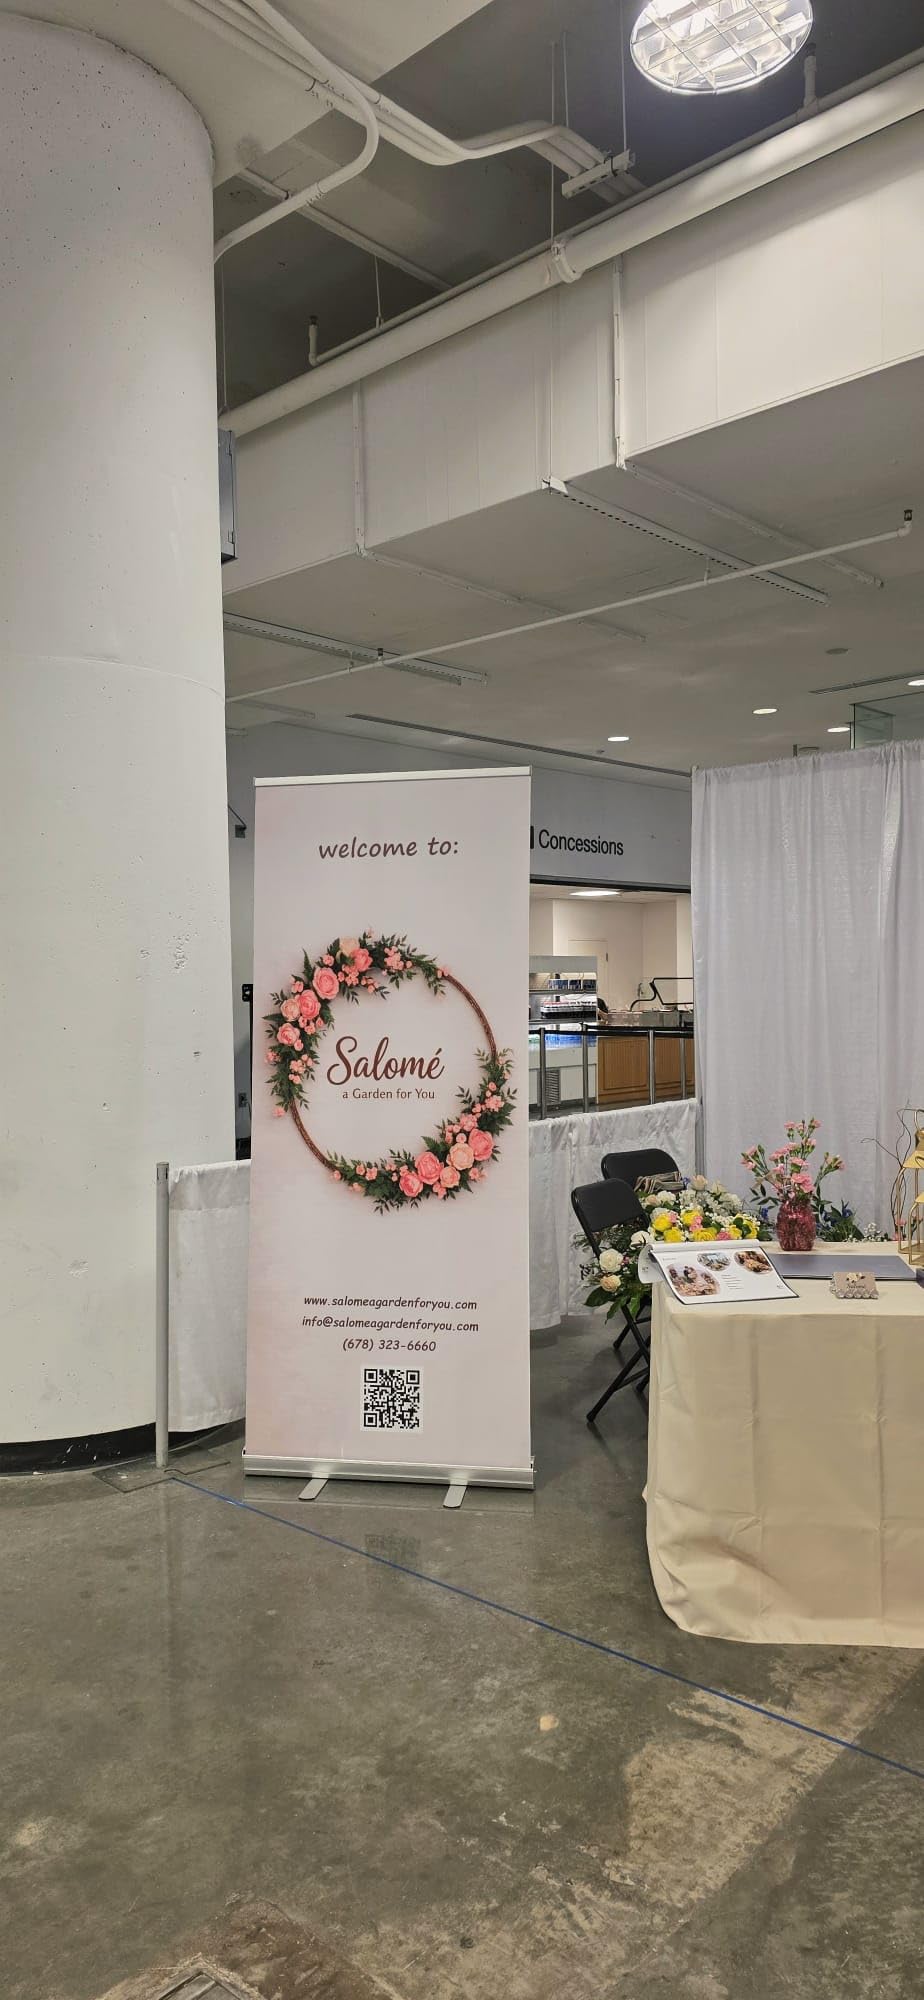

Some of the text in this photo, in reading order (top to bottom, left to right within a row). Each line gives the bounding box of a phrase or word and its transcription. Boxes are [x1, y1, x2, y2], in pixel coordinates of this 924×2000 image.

[318, 836, 459, 858] welcome to:
[538, 829, 624, 856] Concessions
[327, 1036, 445, 1086] Salomé
[342, 1087, 435, 1099] a Garden for You
[304, 1296, 477, 1311] www.salomeagardenforyou.com
[302, 1316, 479, 1333] info@salomeagardenforyou.com
[342, 1338, 437, 1352] (678) 323-6660
